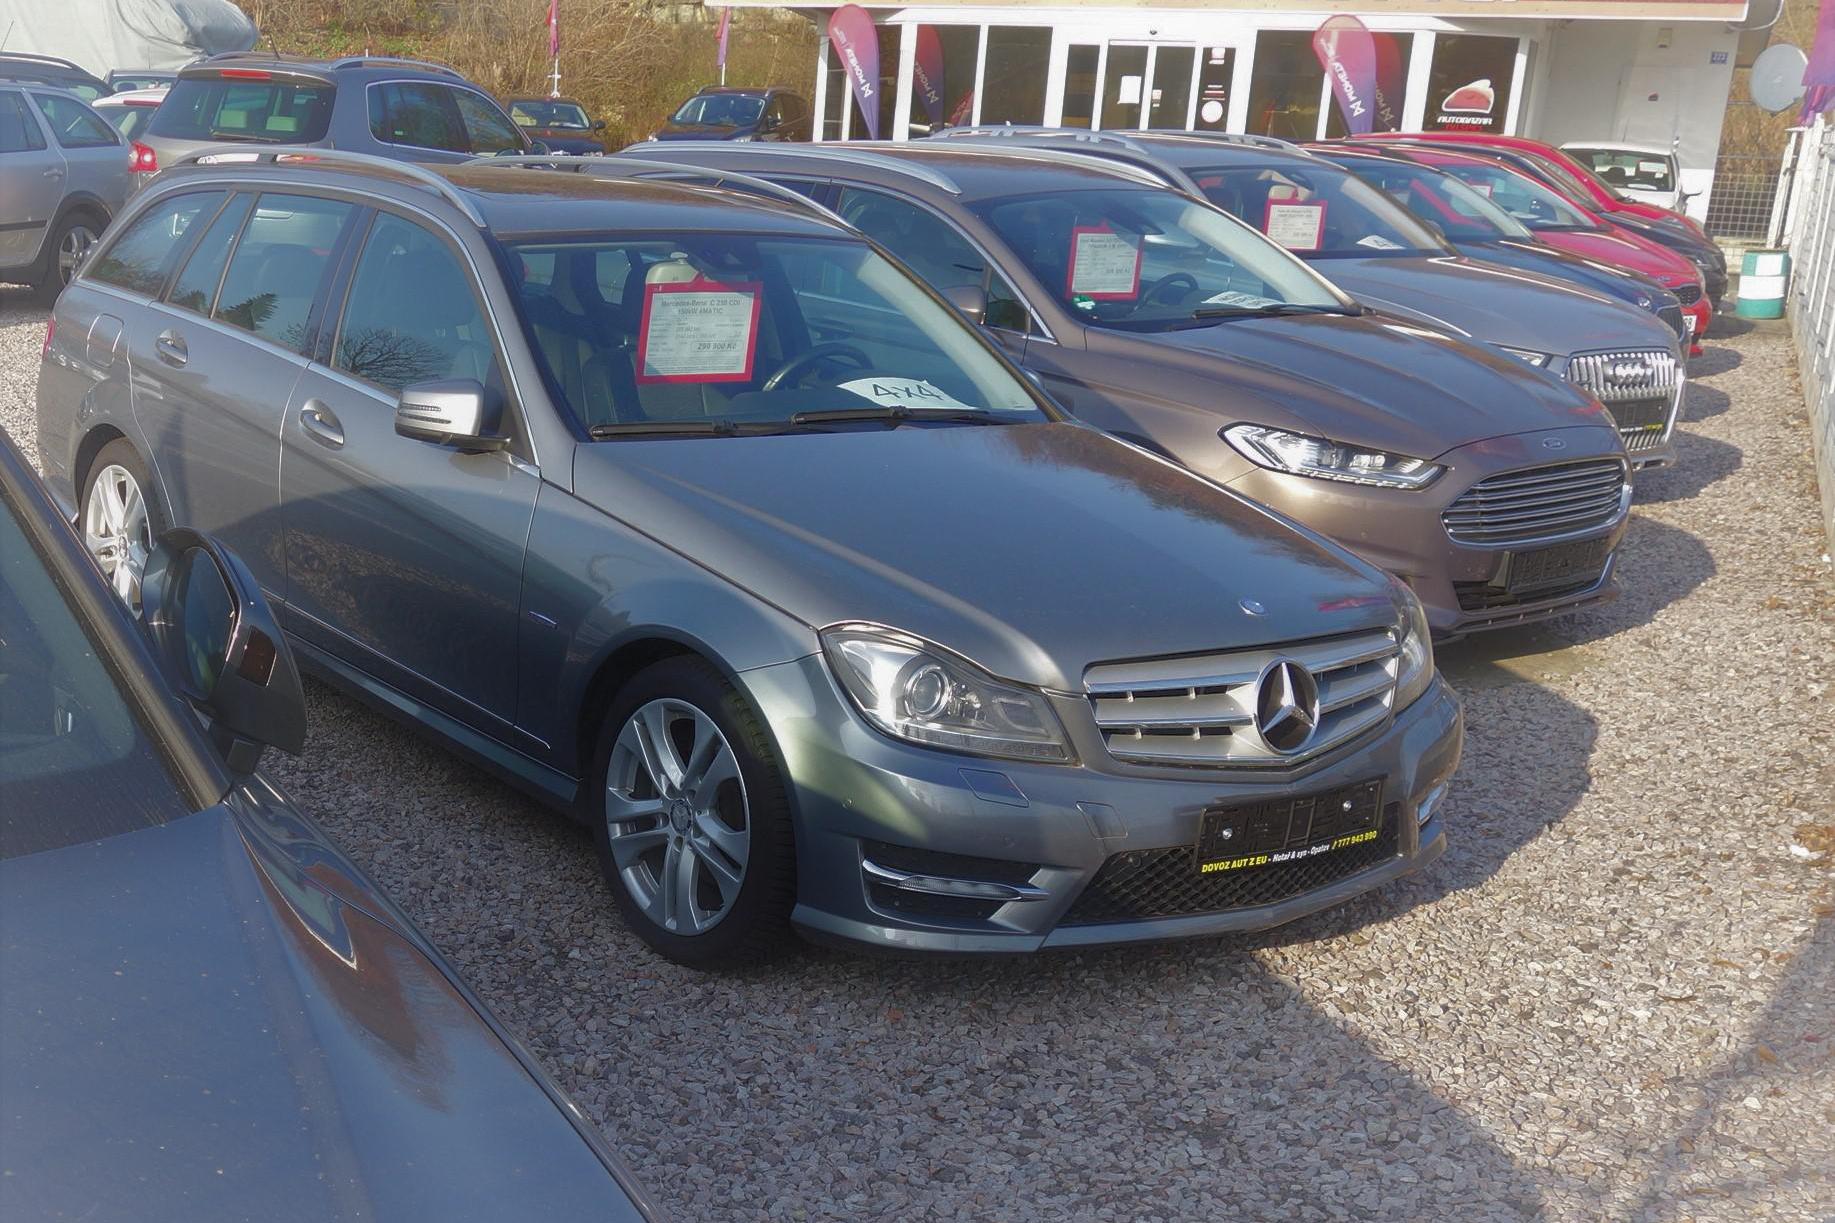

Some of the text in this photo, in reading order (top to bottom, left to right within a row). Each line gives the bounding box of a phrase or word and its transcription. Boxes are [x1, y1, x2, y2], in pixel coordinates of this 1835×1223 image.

[1201, 861, 1231, 873] DOVOZ
[1231, 858, 1249, 869] AUT
[1248, 857, 1256, 866] Z
[1256, 855, 1268, 865] EU
